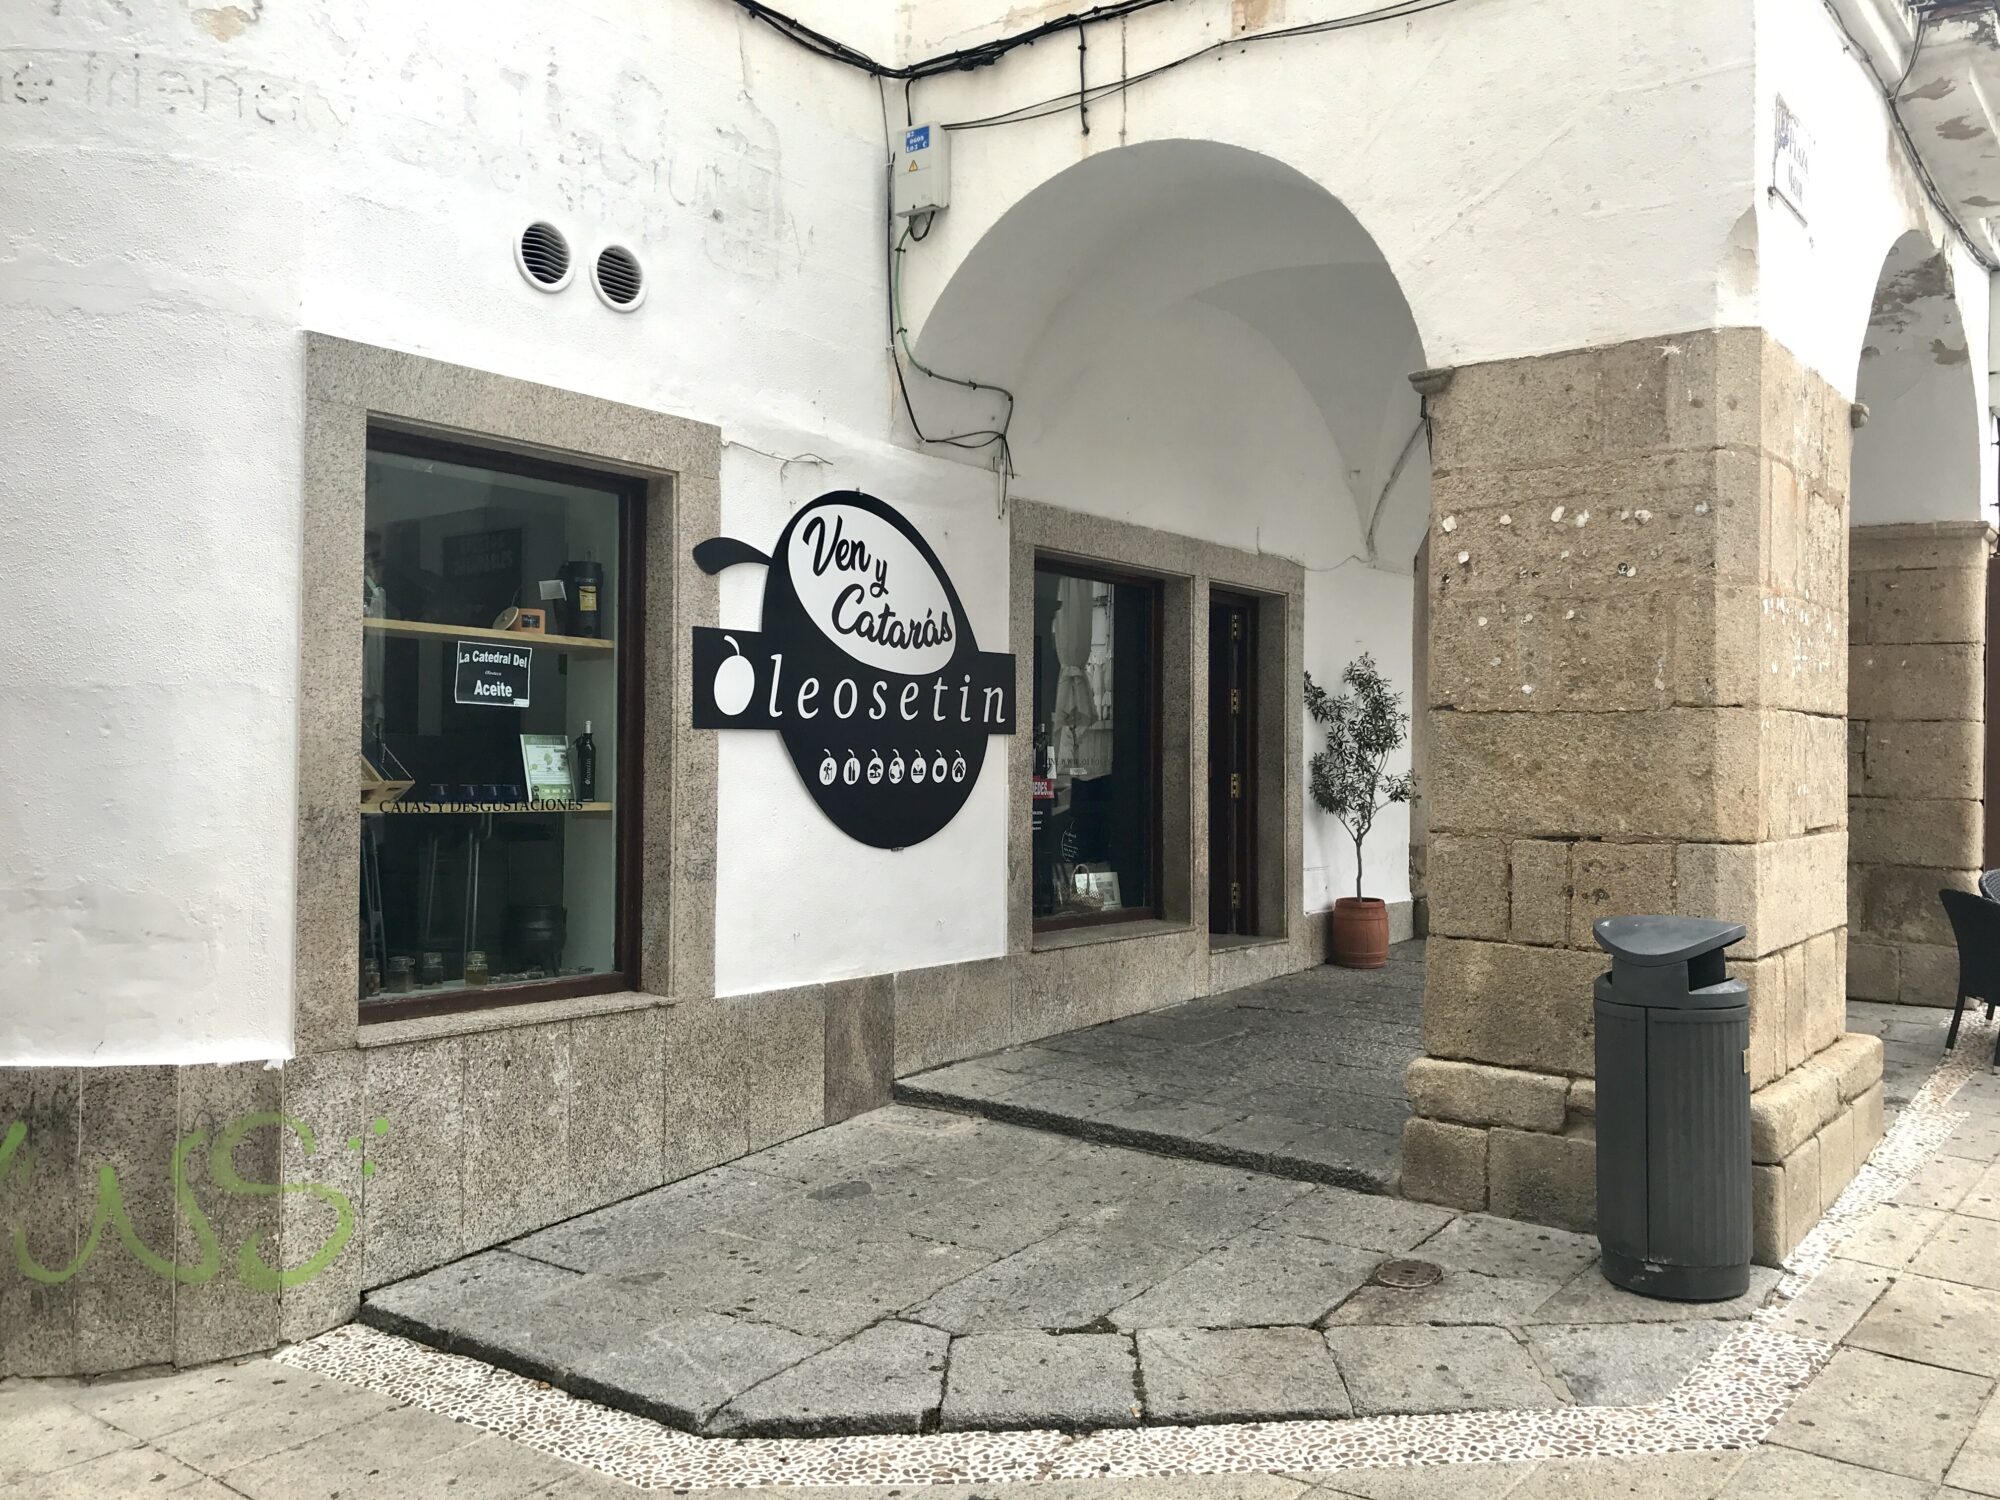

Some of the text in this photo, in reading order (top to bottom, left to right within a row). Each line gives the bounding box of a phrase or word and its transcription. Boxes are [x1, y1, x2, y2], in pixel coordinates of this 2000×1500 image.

[1788, 127, 1808, 175] PLAZA
[803, 515, 889, 598] Ven y
[831, 583, 953, 650] Catarás
[459, 650, 528, 669] La Catedral Del
[473, 679, 513, 698] Aceite
[379, 797, 584, 813] CATAS Y DESGUSTACIONES
